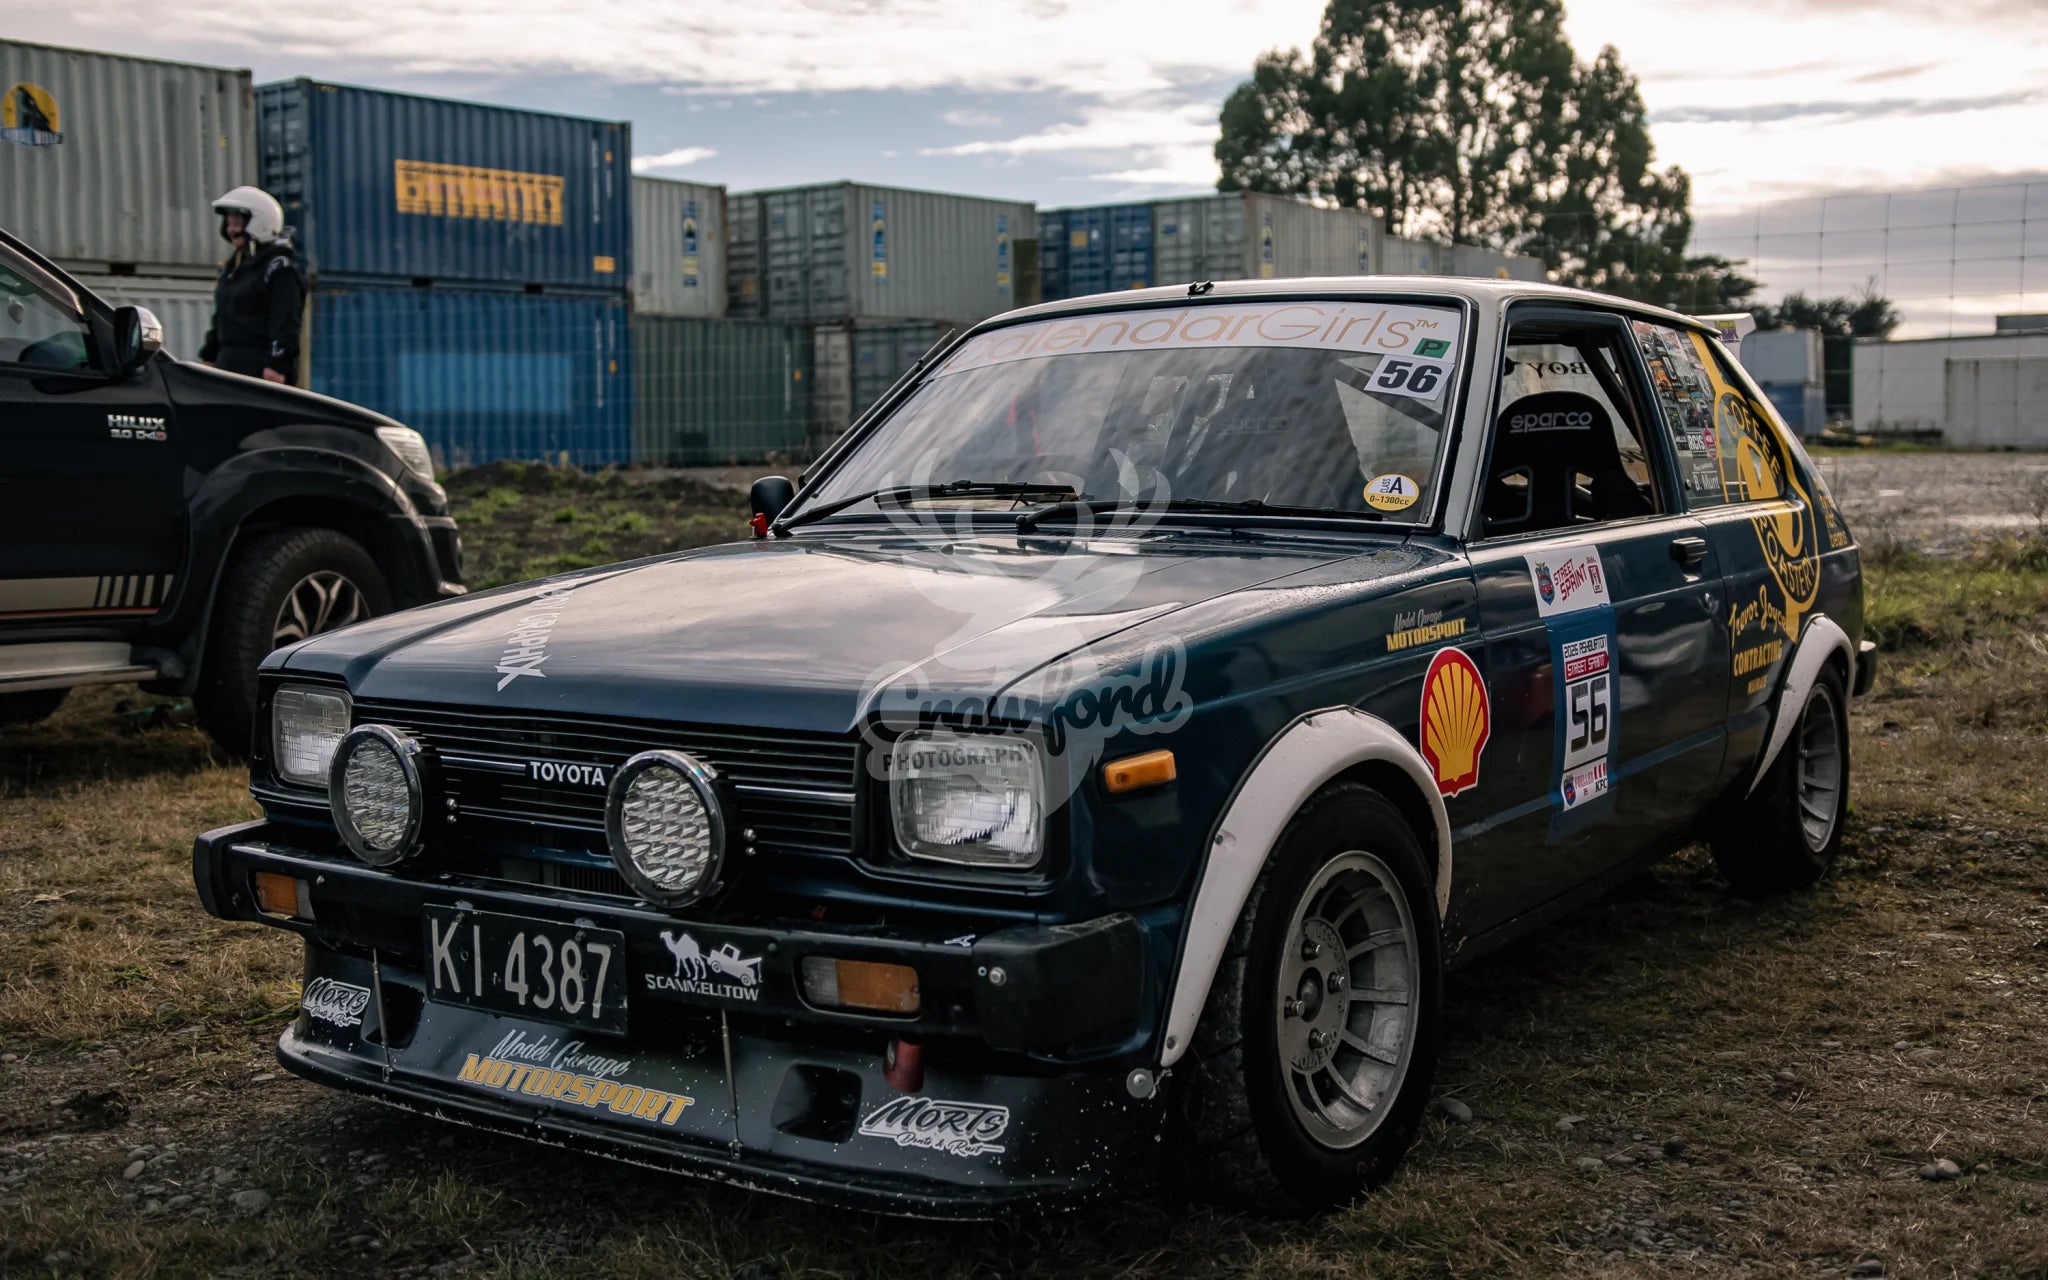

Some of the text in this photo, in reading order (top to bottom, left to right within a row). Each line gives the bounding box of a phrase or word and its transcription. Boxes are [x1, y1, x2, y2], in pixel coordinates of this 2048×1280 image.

[1377, 360, 1443, 393] 56
[107, 414, 165, 430] HILUX
[1511, 411, 1593, 433] sparco
[1723, 400, 1780, 480] COFFEE
[1369, 495, 1410, 505] 0-1300cc
[1389, 476, 1403, 494] A
[1553, 558, 1575, 586] STREET
[1560, 563, 1587, 602] SPRINT
[1386, 618, 1466, 652] MOTORSPORT
[1571, 676, 1607, 753] 56
[530, 761, 606, 786] TOYOTA
[1595, 778, 1607, 792] KFC
[504, 931, 611, 1019] 4387
[489, 1028, 632, 1077] Model Garage
[457, 1053, 695, 1125] MOTORSPORT
